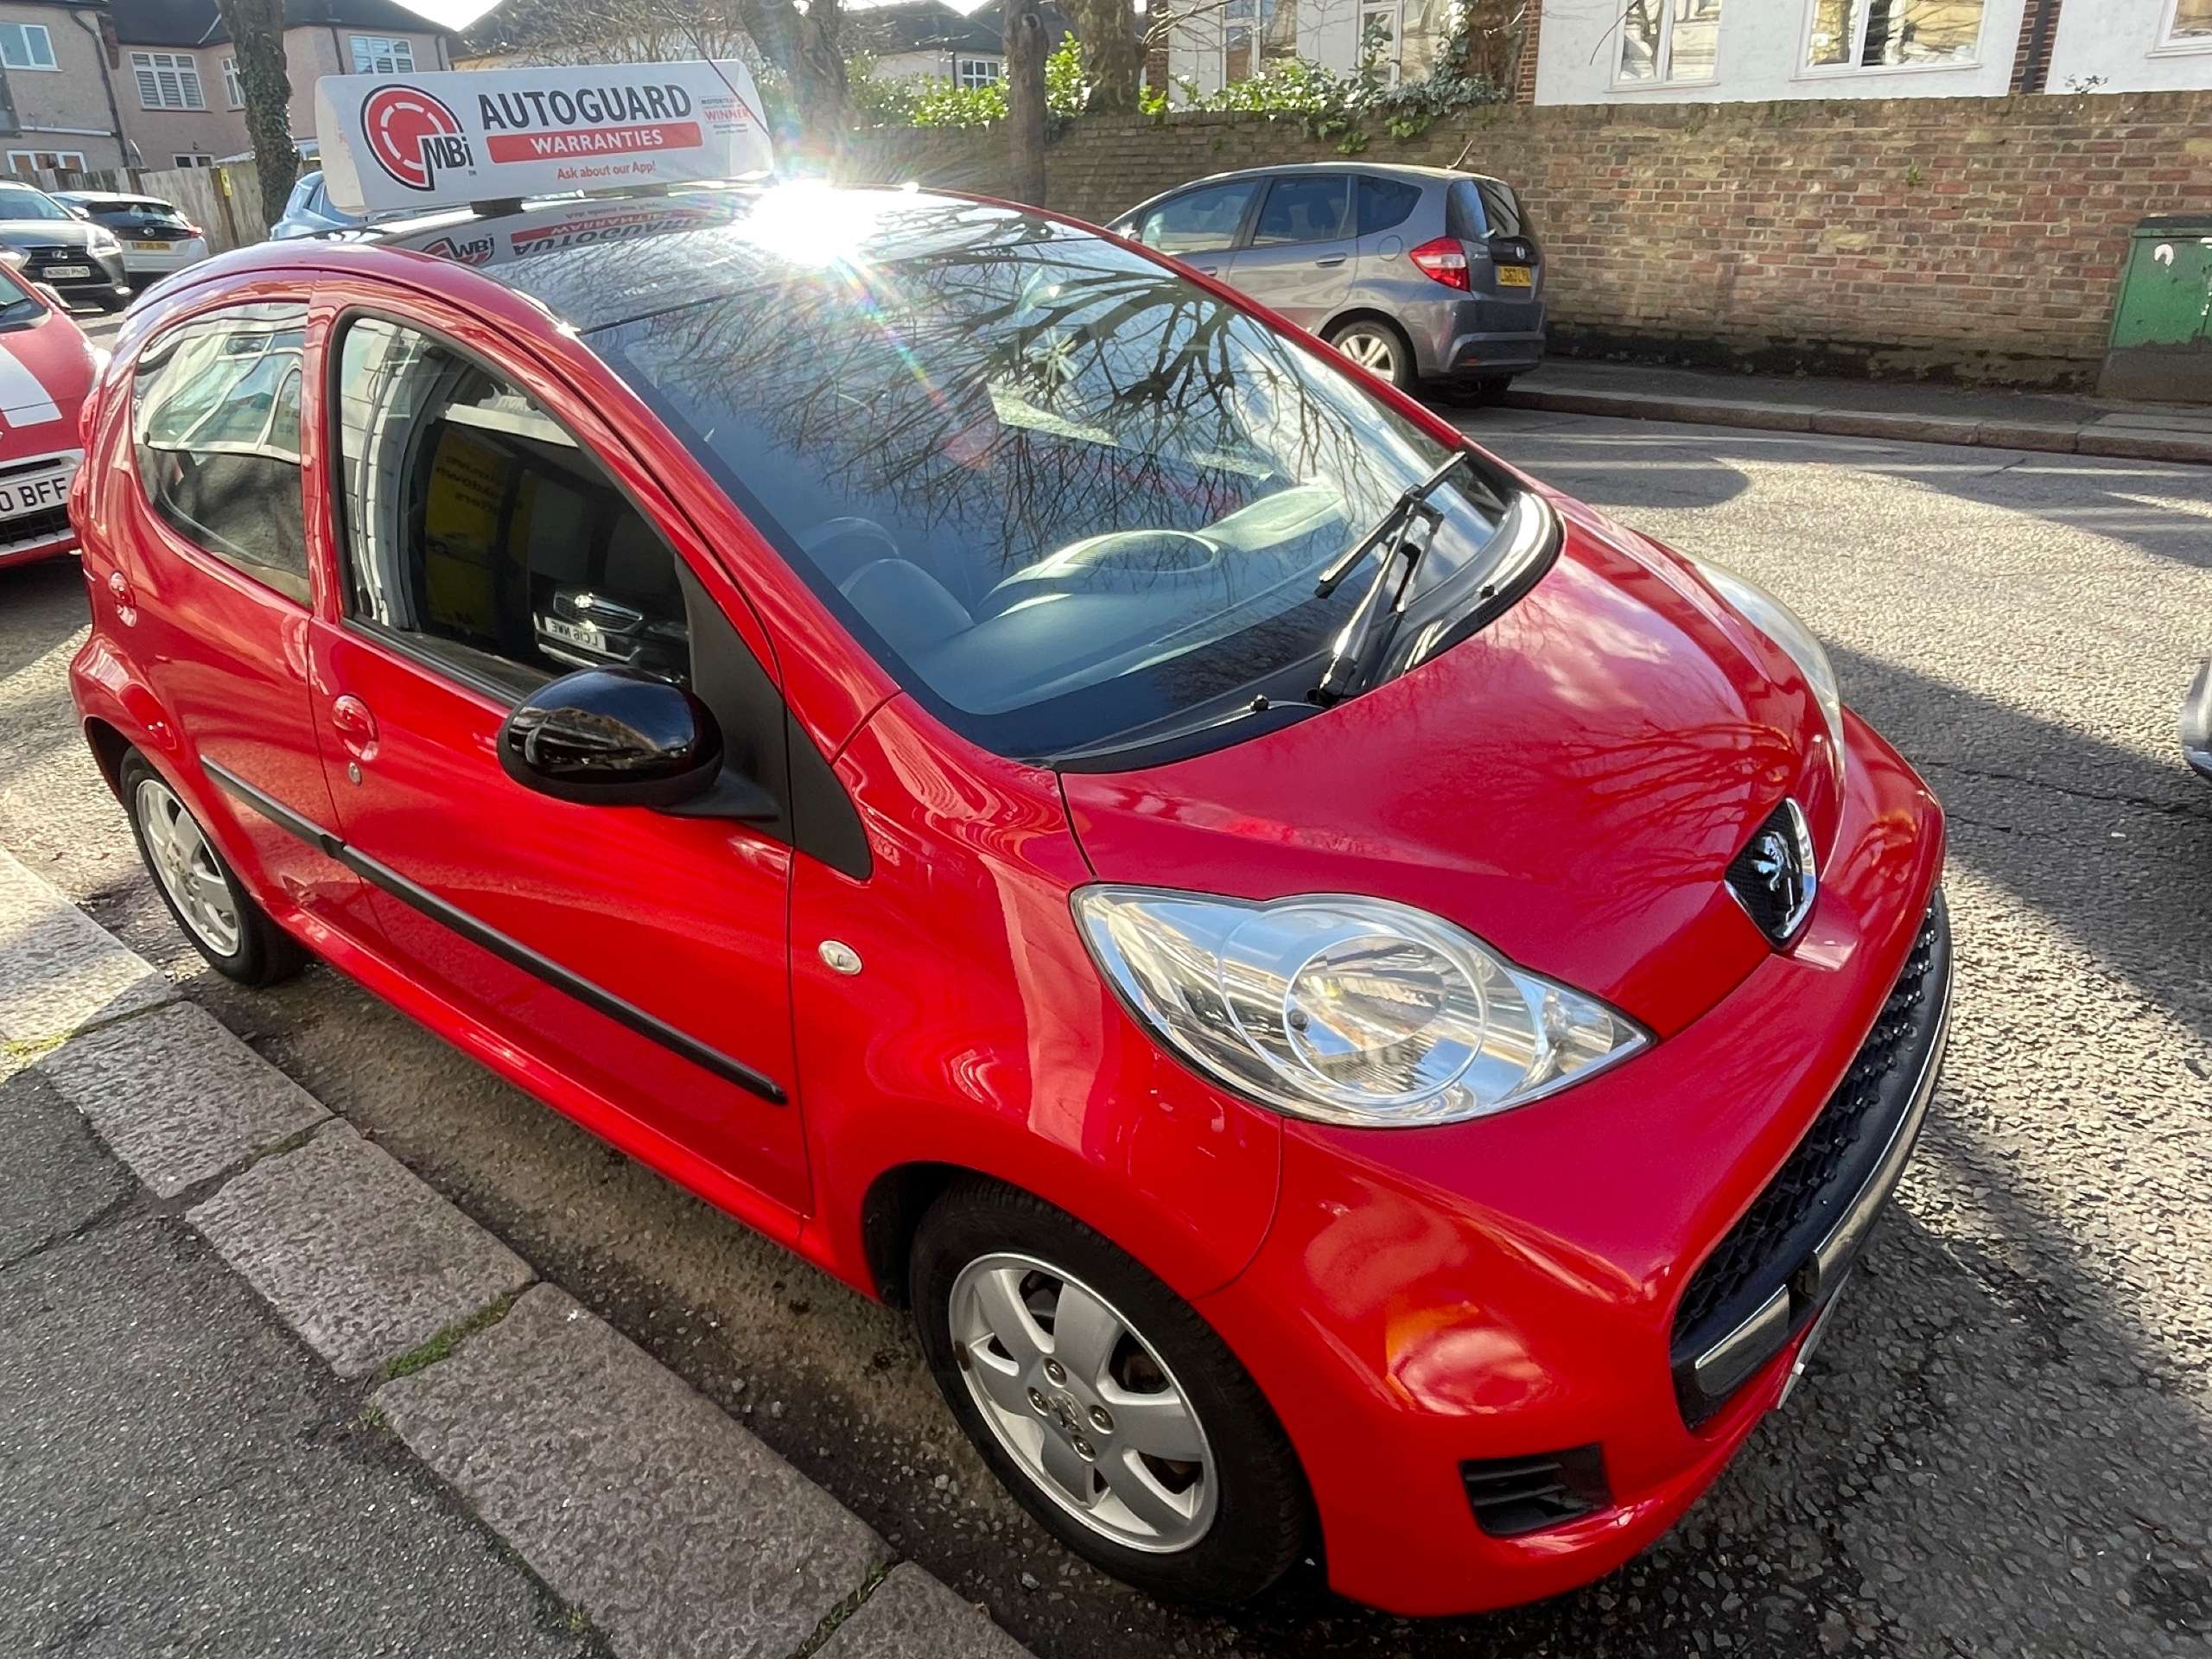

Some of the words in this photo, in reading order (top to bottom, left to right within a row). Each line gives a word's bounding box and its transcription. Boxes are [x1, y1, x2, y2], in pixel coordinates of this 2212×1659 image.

[478, 85, 691, 130] AUTOGUARD
[704, 107, 754, 120] WINNER
[421, 136, 474, 170] MBi
[531, 130, 664, 155] WARRANTIES
[557, 167, 578, 180] Ask
[580, 165, 610, 177] about
[613, 163, 631, 174] our
[632, 160, 657, 174] App!
[17, 477, 67, 507] BFF
